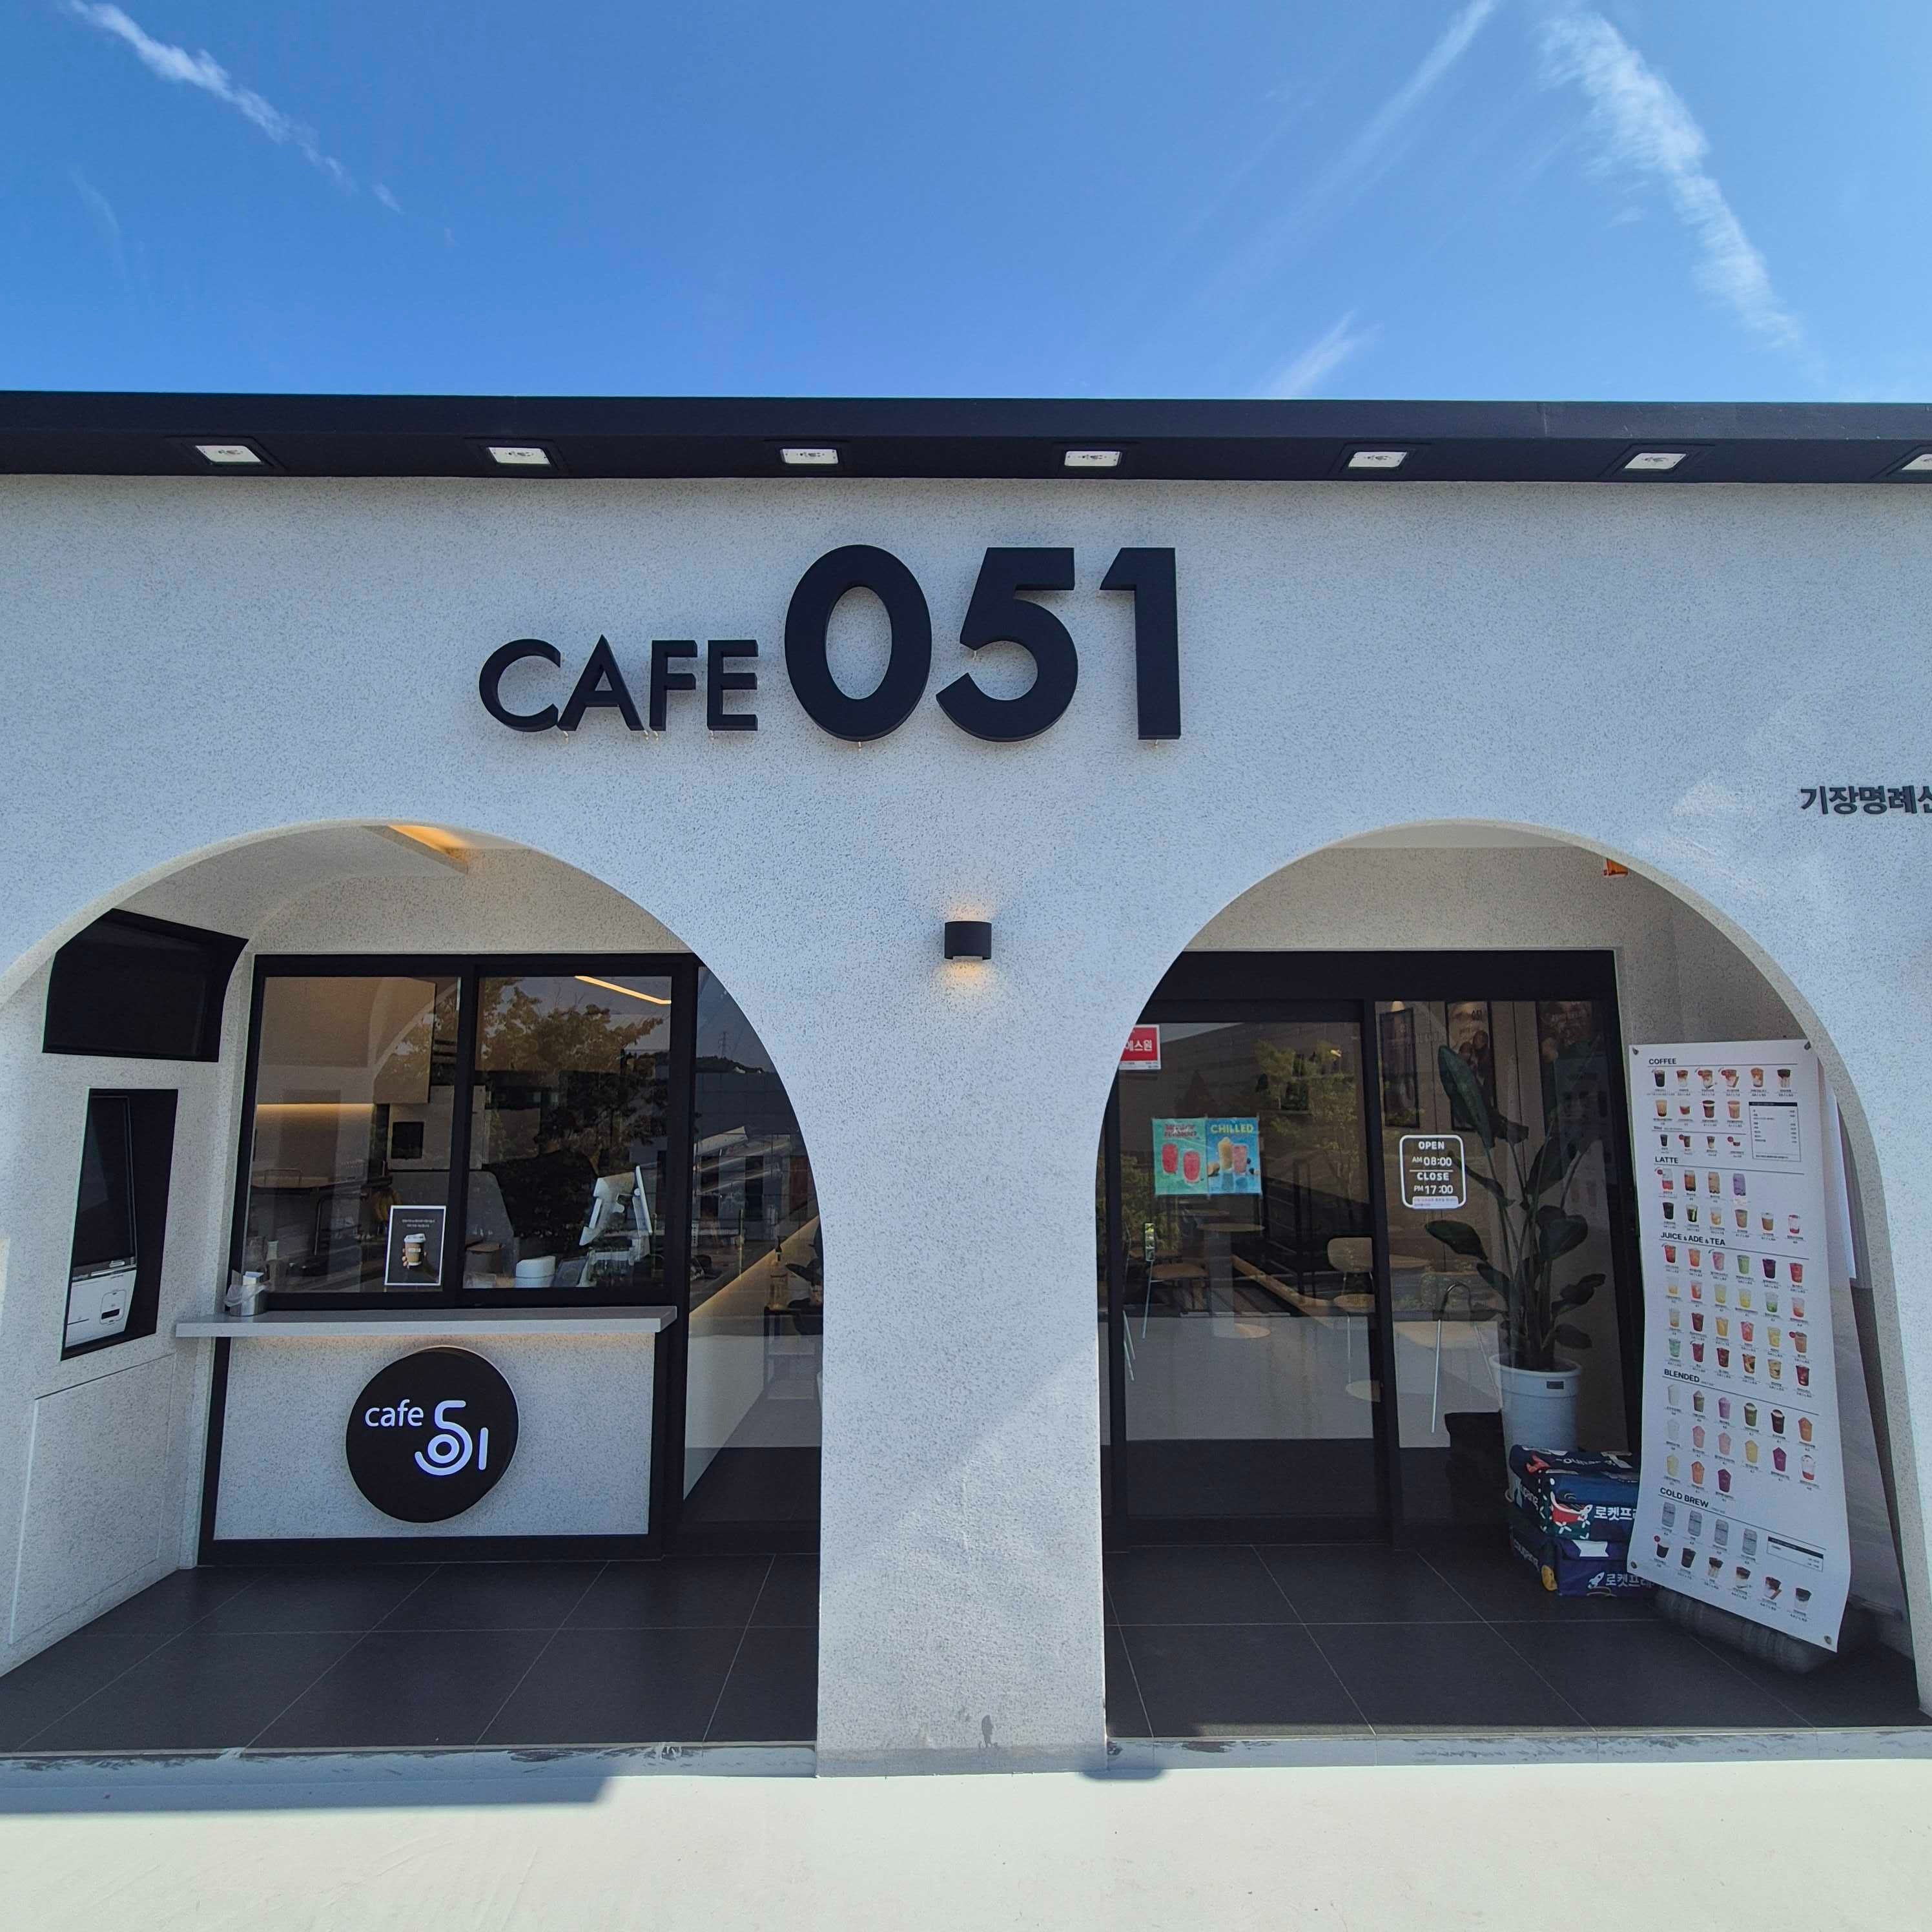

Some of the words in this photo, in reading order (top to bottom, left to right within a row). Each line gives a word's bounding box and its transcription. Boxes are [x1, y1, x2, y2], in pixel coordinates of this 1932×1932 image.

[478, 634, 758, 733] CAFE
[784, 544, 1181, 743] 051
[1210, 1124, 1253, 1134] CHILLED
[1418, 1141, 1444, 1149] OPEN
[1423, 1156, 1452, 1167] 08:00
[1417, 1172, 1450, 1181] CLOSE
[1424, 1185, 1454, 1195] 17:00
[1709, 1237, 1725, 1246] TEA
[1664, 1368, 1700, 1383] BLENDED
[364, 1399, 424, 1427] cafe
[1660, 1487, 1682, 1499] COLD
[1684, 1494, 1709, 1508] BREW
[1594, 1506, 1637, 1521] 로켓프
[1605, 1573, 1657, 1588] 로켓프
